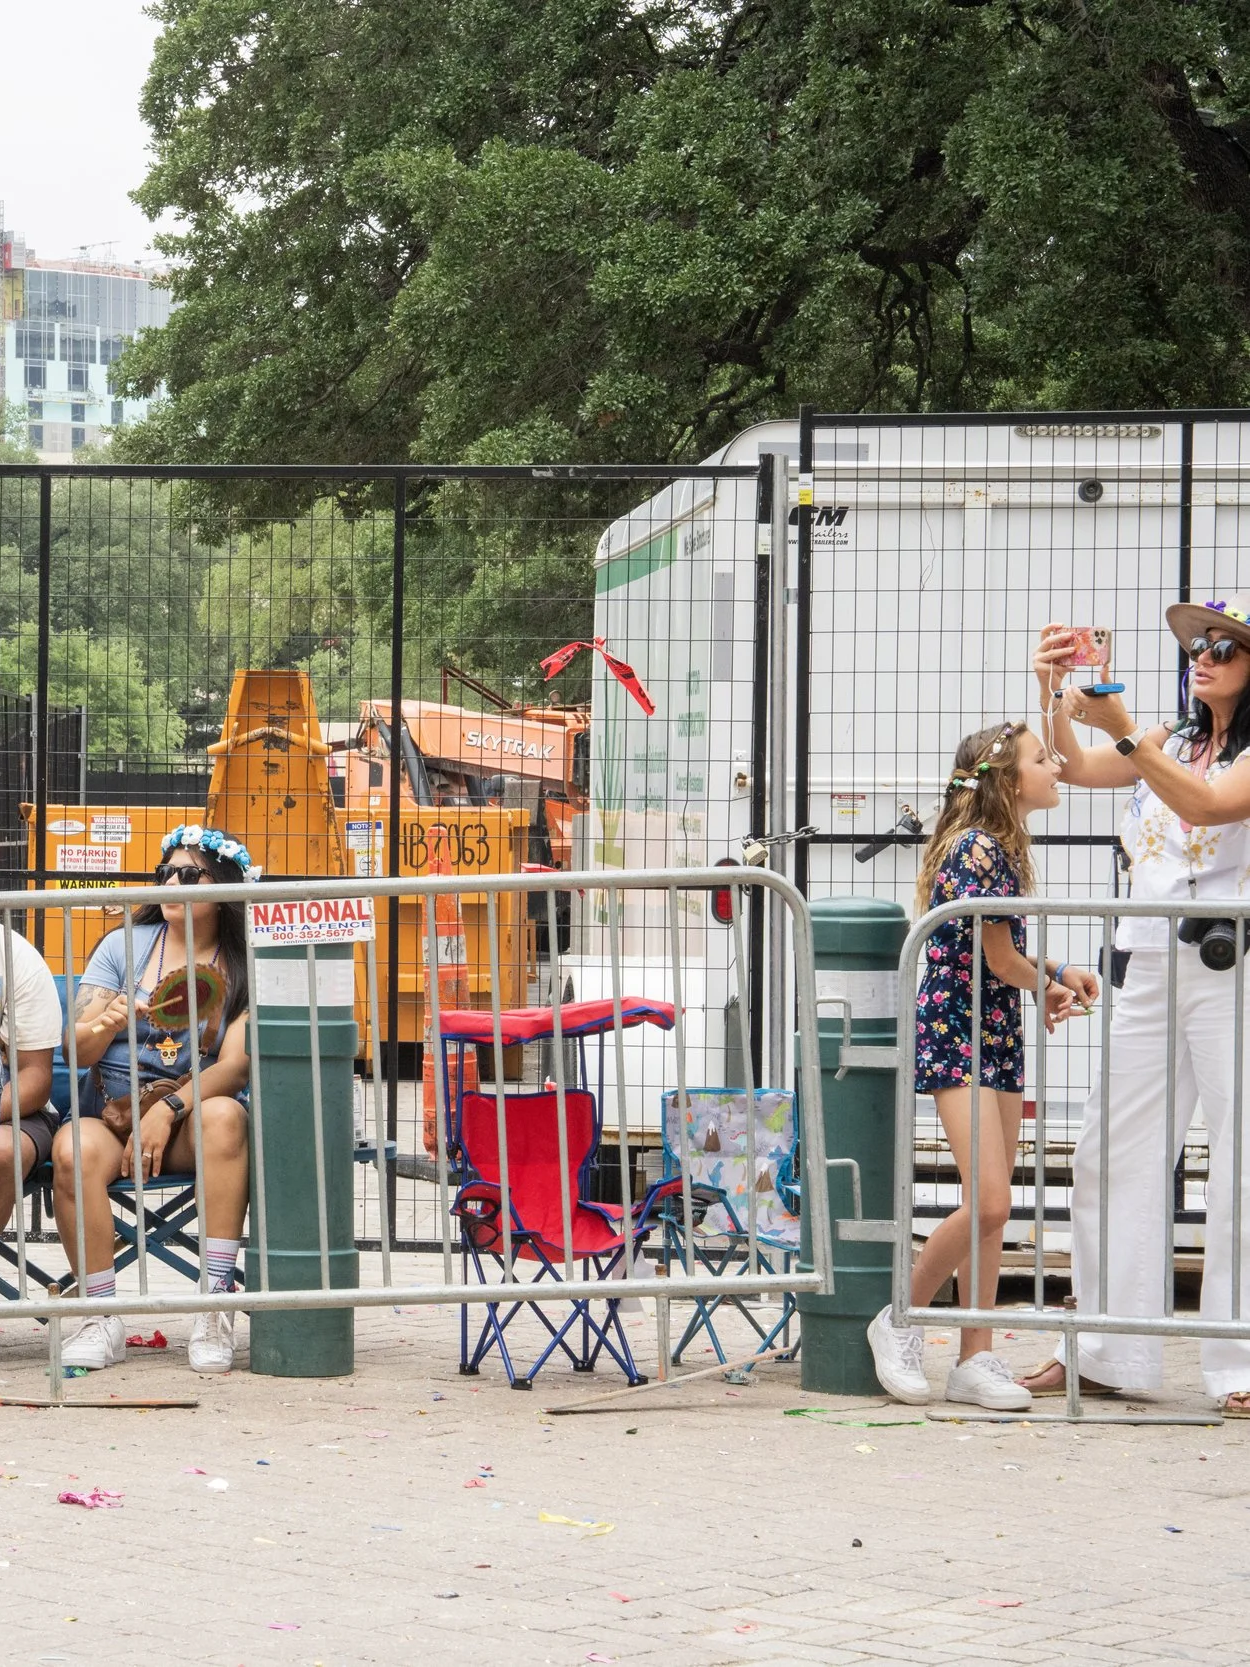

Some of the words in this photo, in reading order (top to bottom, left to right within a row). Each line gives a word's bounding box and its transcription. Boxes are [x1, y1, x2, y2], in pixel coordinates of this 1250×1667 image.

[466, 731, 555, 762] SKYTRAK
[399, 822, 490, 869] HB063
[76, 849, 118, 858] PARKING
[59, 880, 116, 889] WARNING
[253, 899, 371, 926] NATIONAL
[254, 921, 371, 933] RENT-A-FENCE
[272, 928, 354, 940] 800-352-5675
